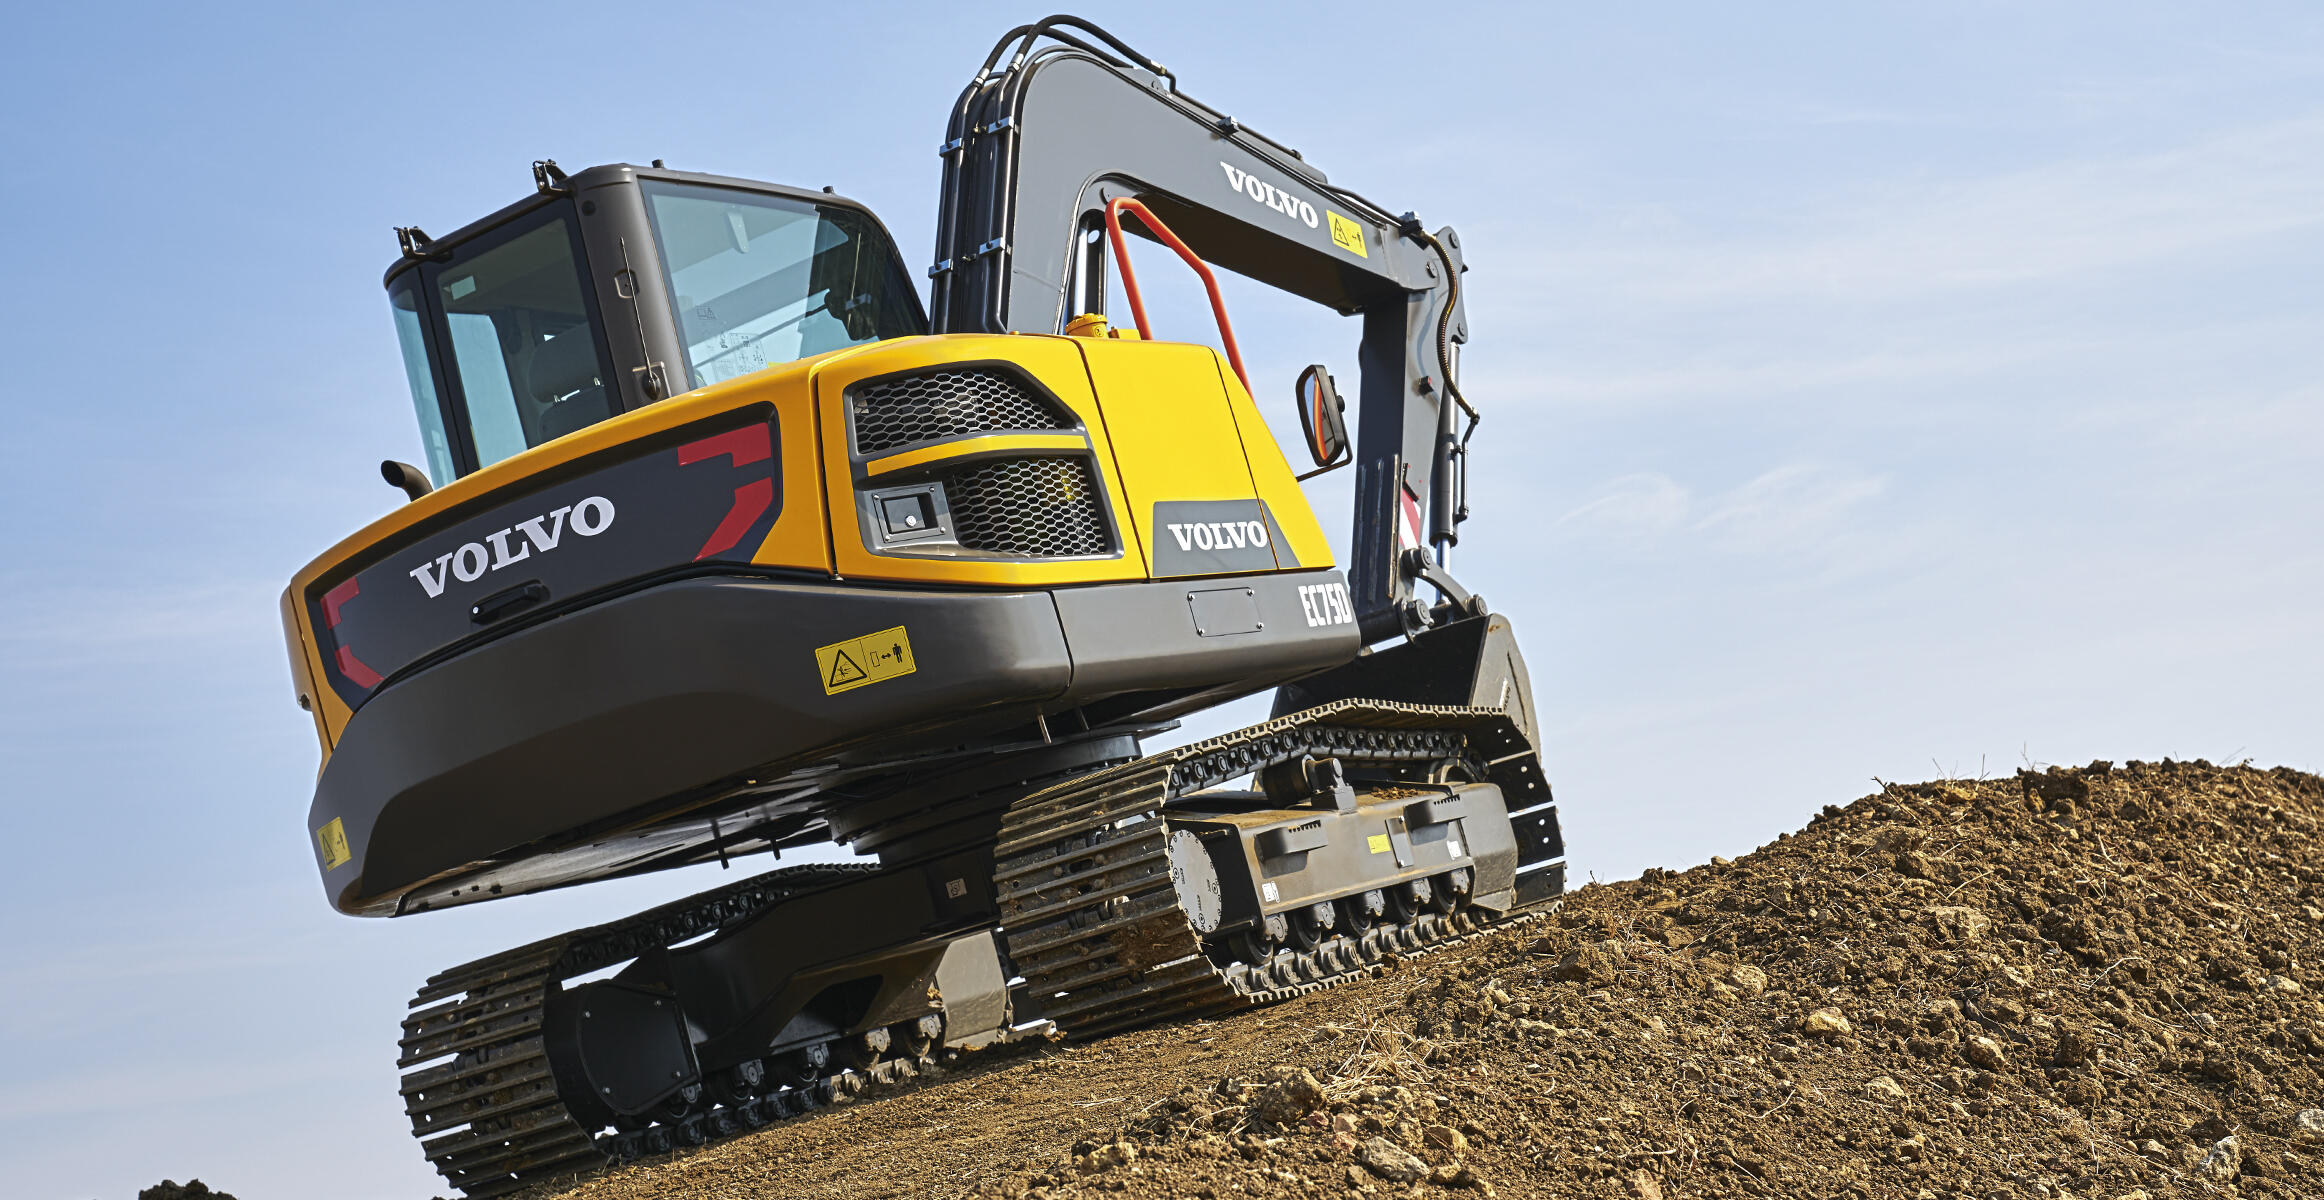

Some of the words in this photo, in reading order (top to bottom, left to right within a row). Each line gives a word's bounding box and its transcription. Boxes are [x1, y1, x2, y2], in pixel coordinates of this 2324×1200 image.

[1220, 161, 1319, 229] VOLVO
[410, 496, 615, 599] VOLVO
[1167, 521, 1268, 551] VOLVO
[1298, 583, 1352, 627] EC75D
